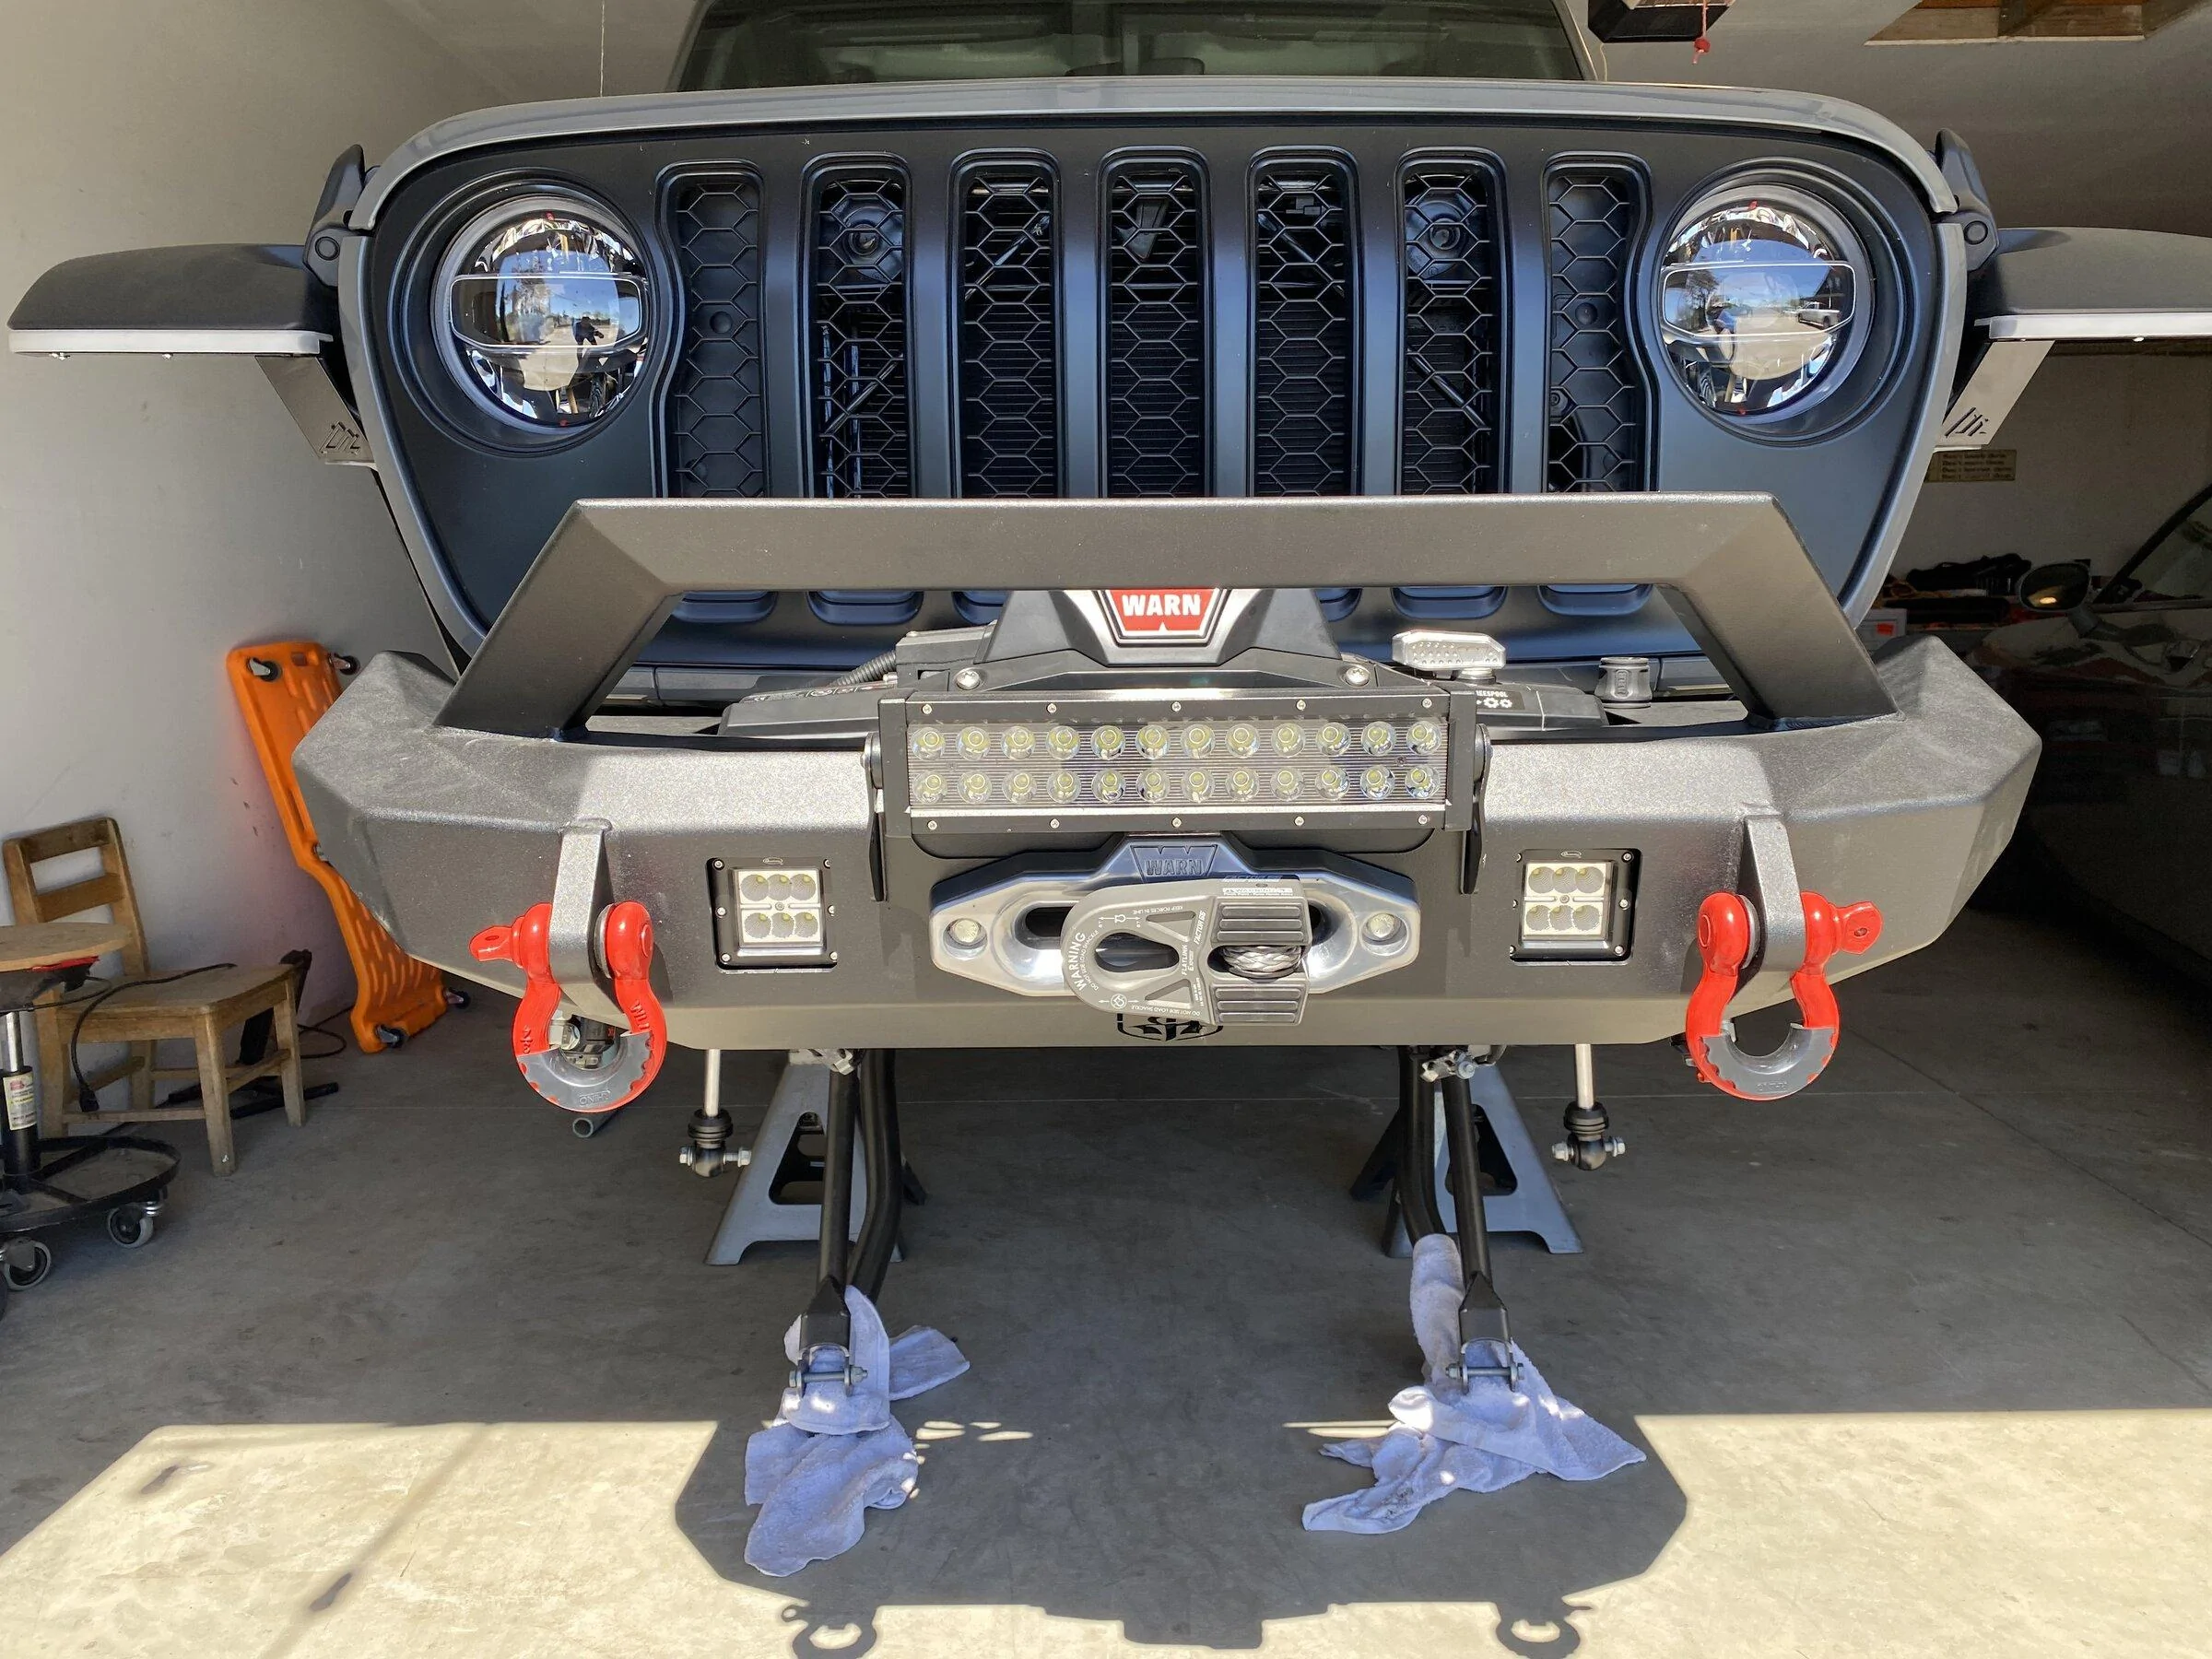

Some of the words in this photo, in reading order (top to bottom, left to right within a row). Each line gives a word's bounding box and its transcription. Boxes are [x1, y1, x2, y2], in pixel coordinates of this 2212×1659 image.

[1122, 594, 1200, 617] WARN
[1146, 859, 1203, 876] WARN
[1194, 919, 1204, 945] FACTOR
[1068, 932, 1087, 991] WARNING
